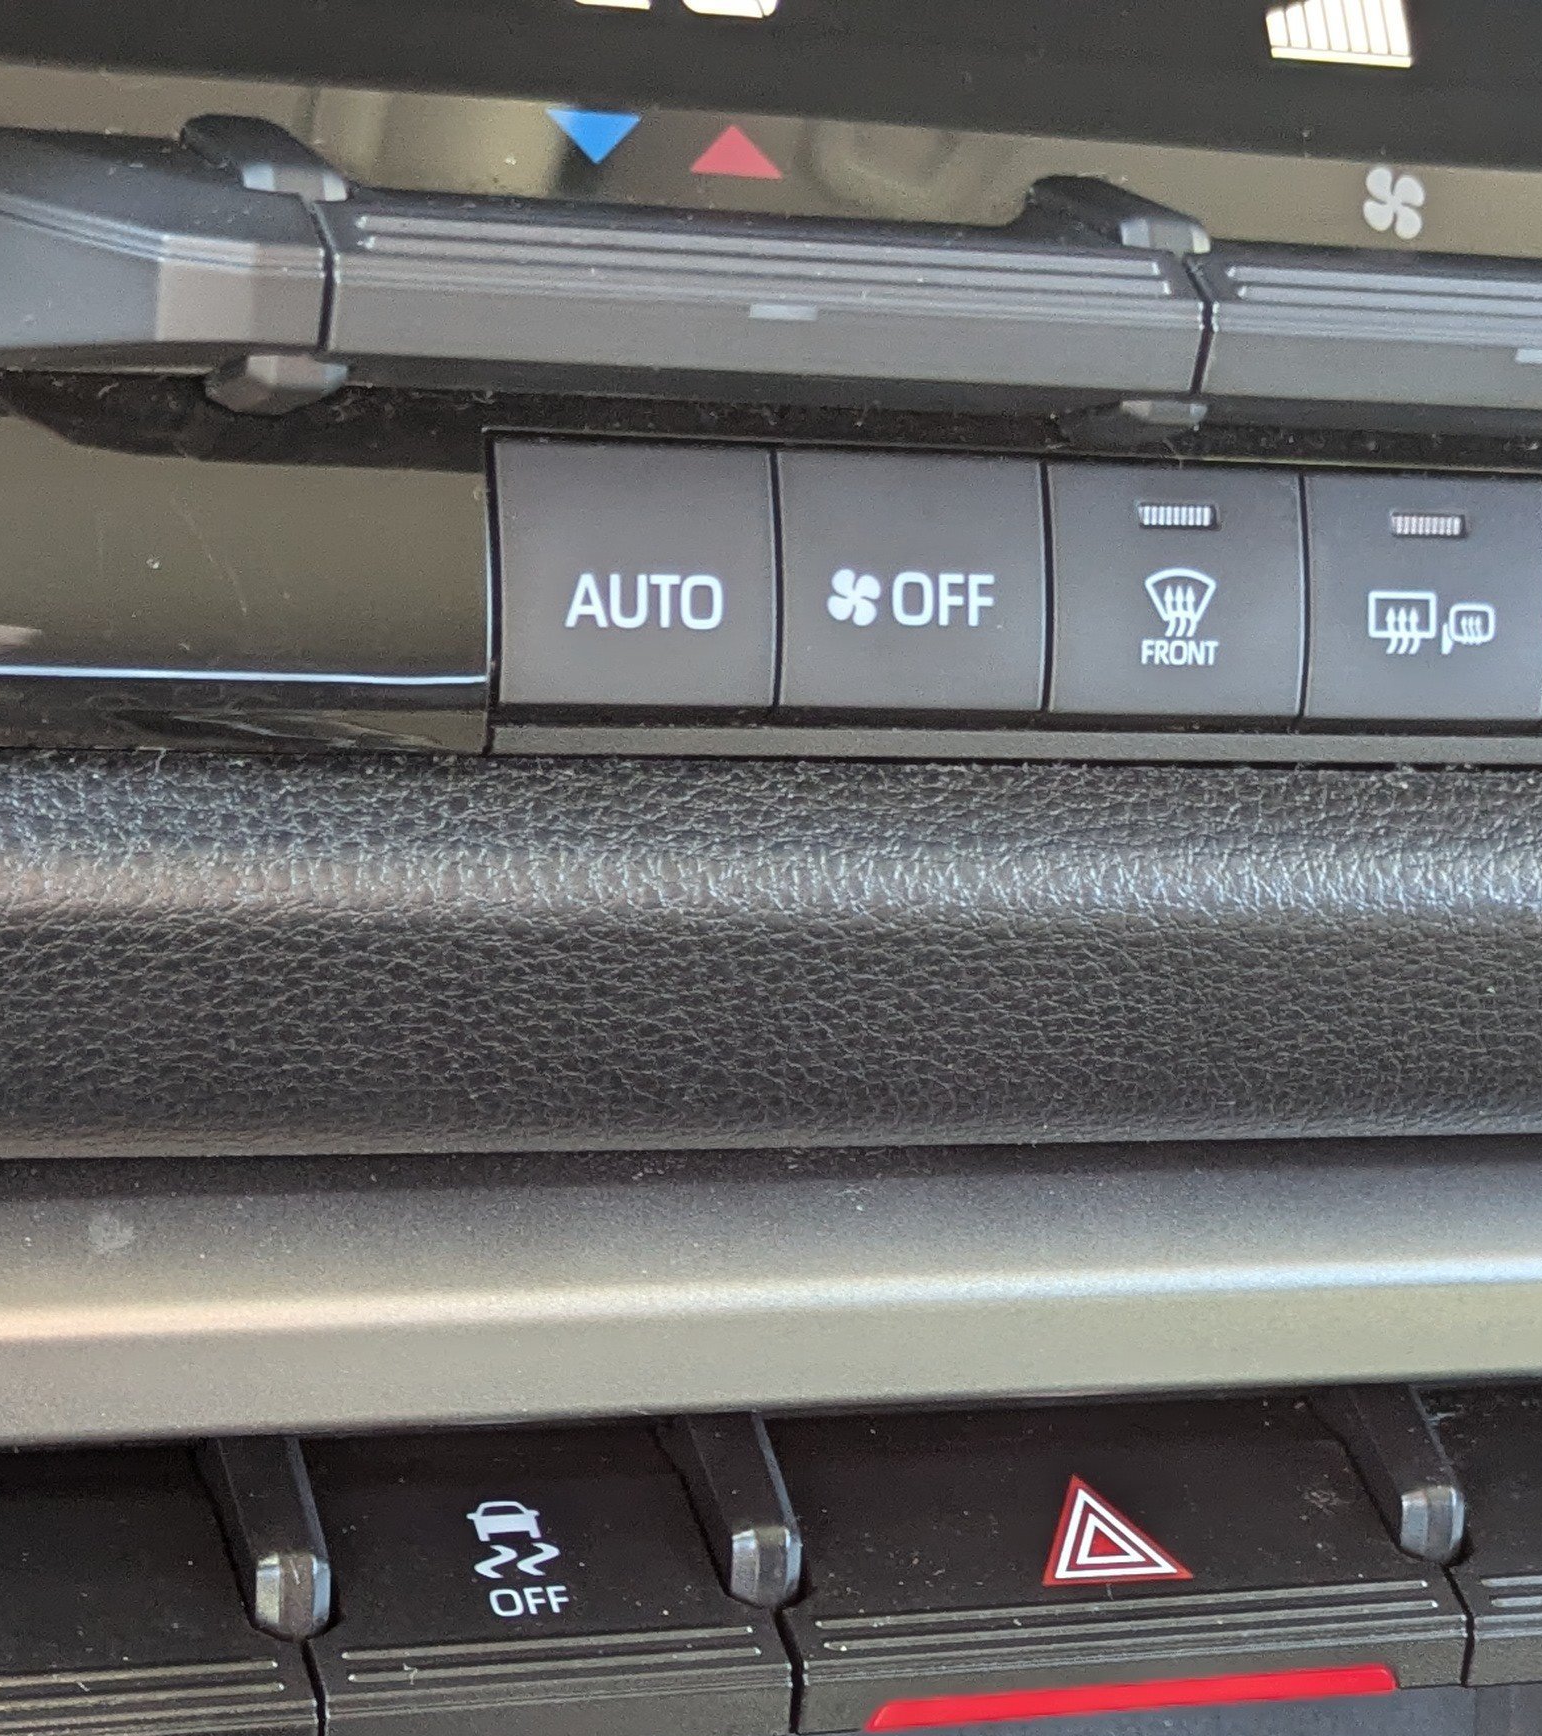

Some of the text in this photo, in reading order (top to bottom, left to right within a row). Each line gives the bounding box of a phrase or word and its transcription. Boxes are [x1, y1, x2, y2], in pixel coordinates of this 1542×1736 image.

[565, 573, 724, 631] AUTO
[891, 573, 996, 626] OFF
[1140, 639, 1219, 666] FRONT
[488, 1585, 569, 1617] OFF
